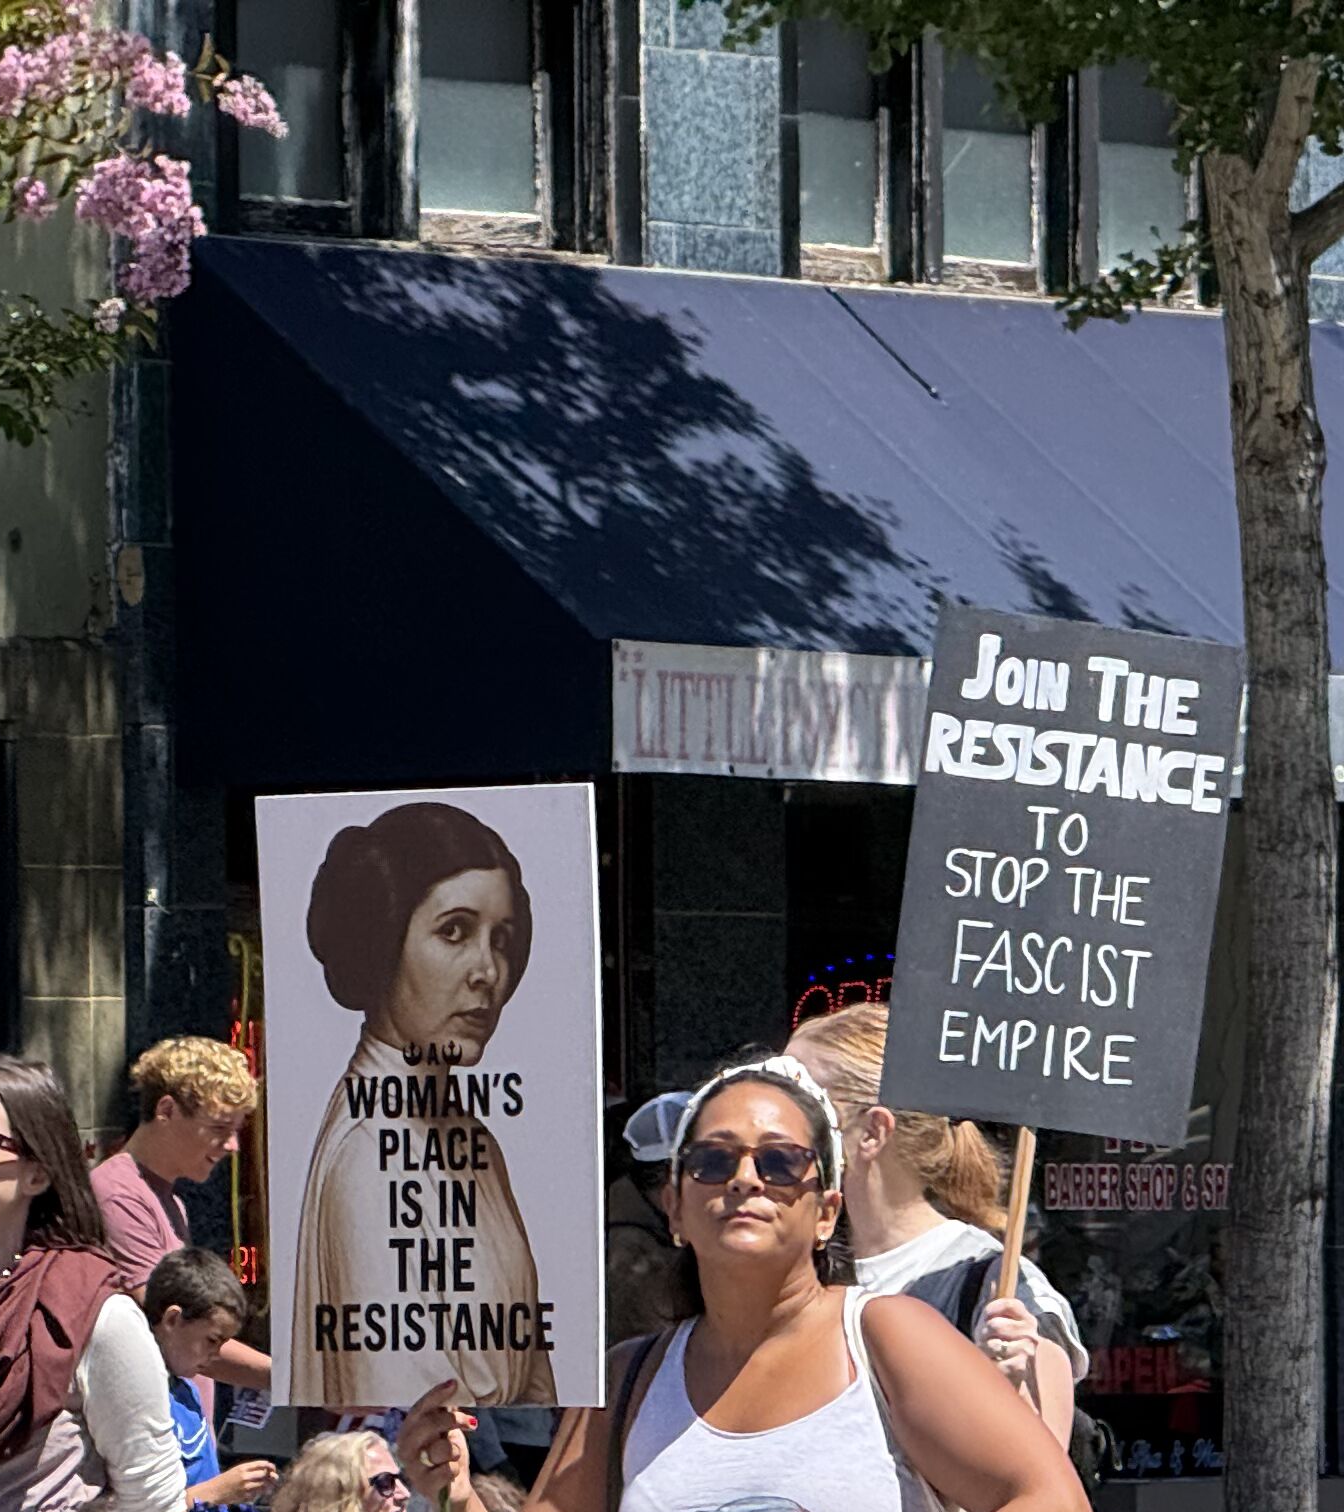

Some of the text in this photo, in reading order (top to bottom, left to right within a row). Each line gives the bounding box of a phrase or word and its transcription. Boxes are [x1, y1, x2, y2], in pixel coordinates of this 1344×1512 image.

[962, 634, 1200, 735] JOIN THE
[925, 712, 1225, 813] RESISTANCE
[1027, 805, 1089, 856] TO
[945, 848, 1150, 926] STOP THE
[951, 919, 1152, 1009] FASCIST
[427, 1043, 439, 1066] A
[939, 1010, 1136, 1086] EMPIRE
[345, 1072, 524, 1119] WOMAN'S
[379, 1127, 488, 1171] PLACE
[389, 1180, 476, 1228] IS IN
[1045, 1162, 1122, 1211] BARBER
[1126, 1163, 1177, 1211] SHOP
[1182, 1164, 1198, 1211] &
[389, 1238, 475, 1292] THE
[315, 1302, 554, 1351] RESISTANCE
